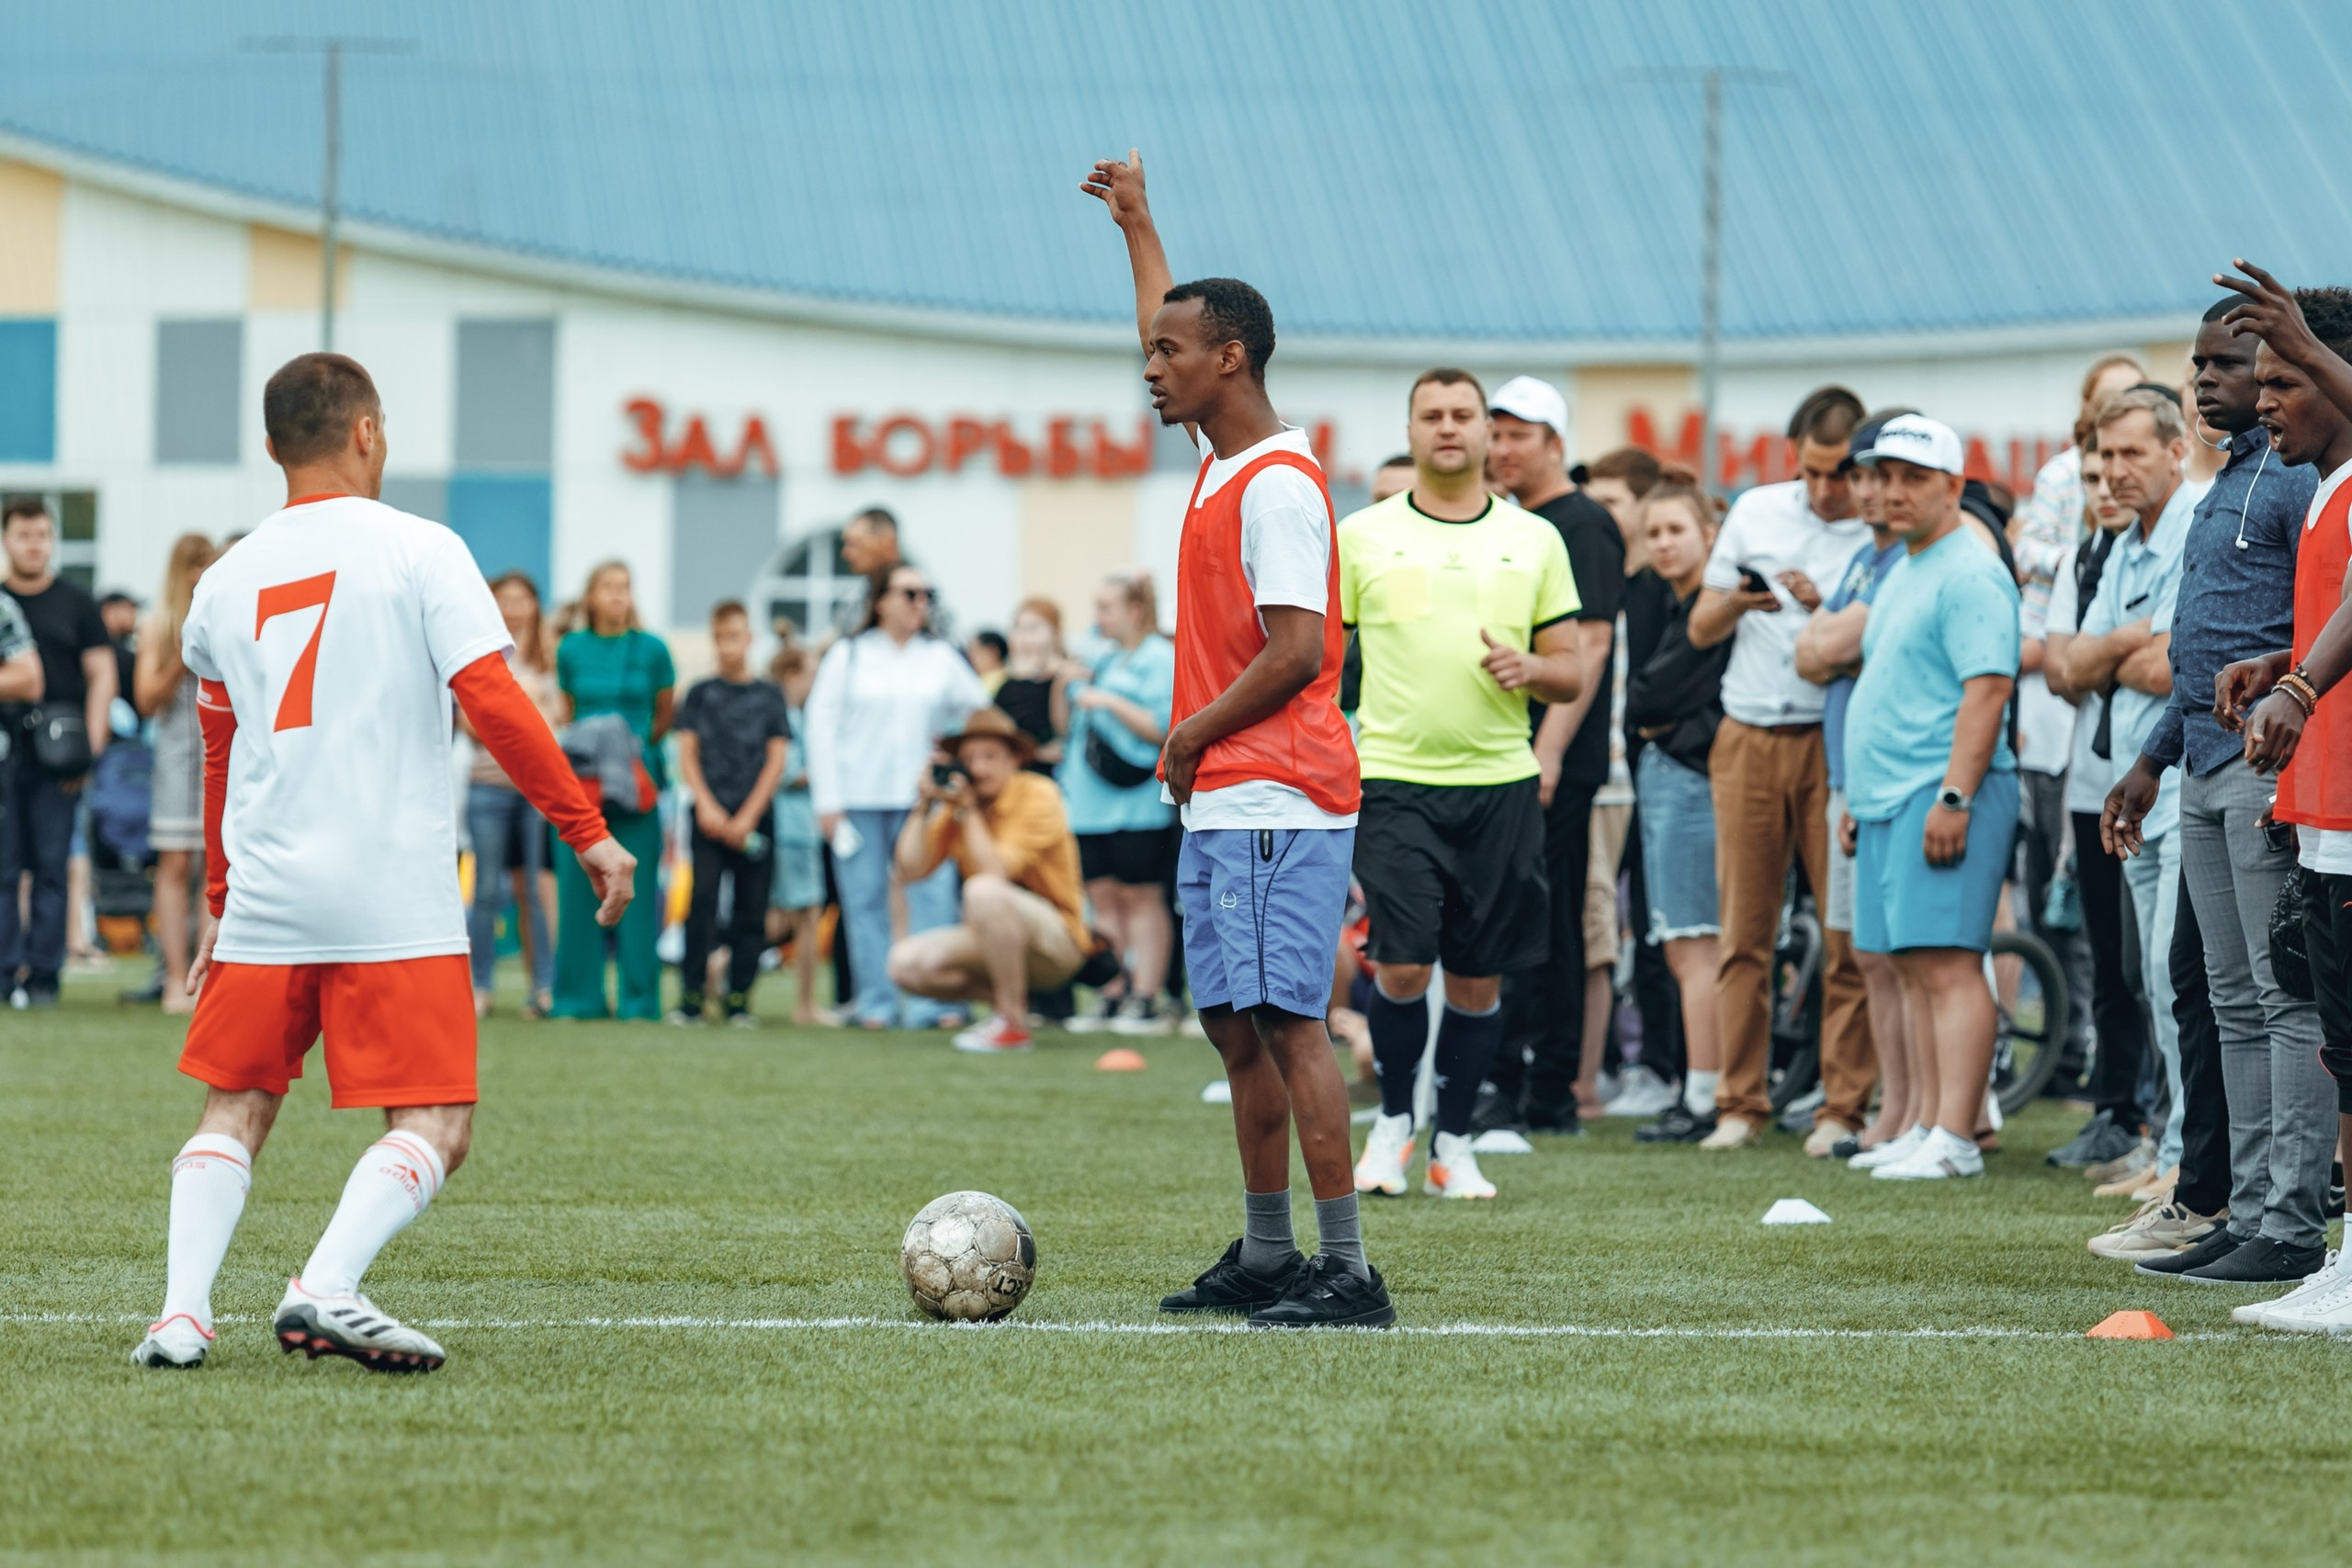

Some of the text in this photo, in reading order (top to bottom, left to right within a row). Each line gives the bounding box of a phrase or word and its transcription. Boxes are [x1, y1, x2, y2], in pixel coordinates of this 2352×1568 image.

[831, 413, 1155, 478] БОРЬБЫ
[254, 570, 337, 734] 7
[379, 1166, 423, 1212] adidas
